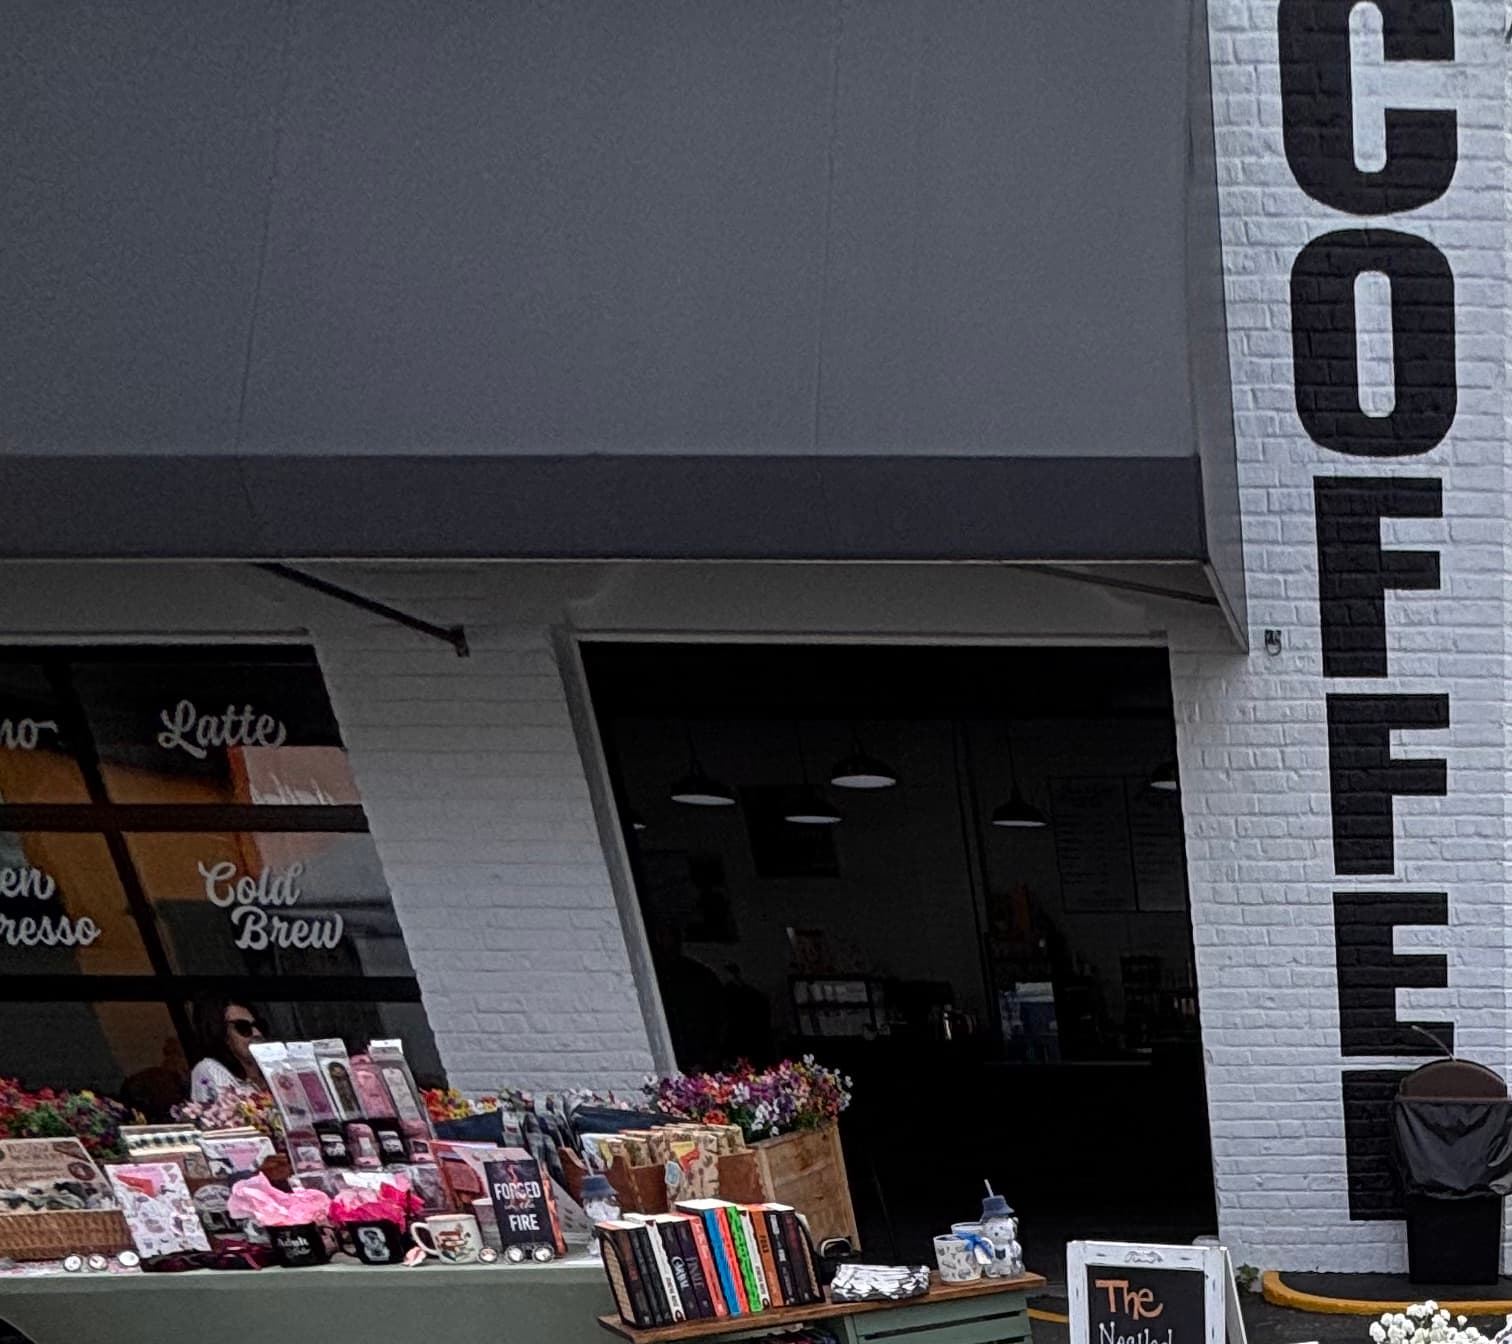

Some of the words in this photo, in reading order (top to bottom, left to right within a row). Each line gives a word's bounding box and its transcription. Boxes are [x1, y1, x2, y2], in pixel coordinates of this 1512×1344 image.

[158, 699, 287, 759] Latte
[198, 861, 303, 907] Cold
[231, 905, 344, 950] Brew
[509, 1214, 540, 1232] FIRE
[1094, 1279, 1164, 1321] The
